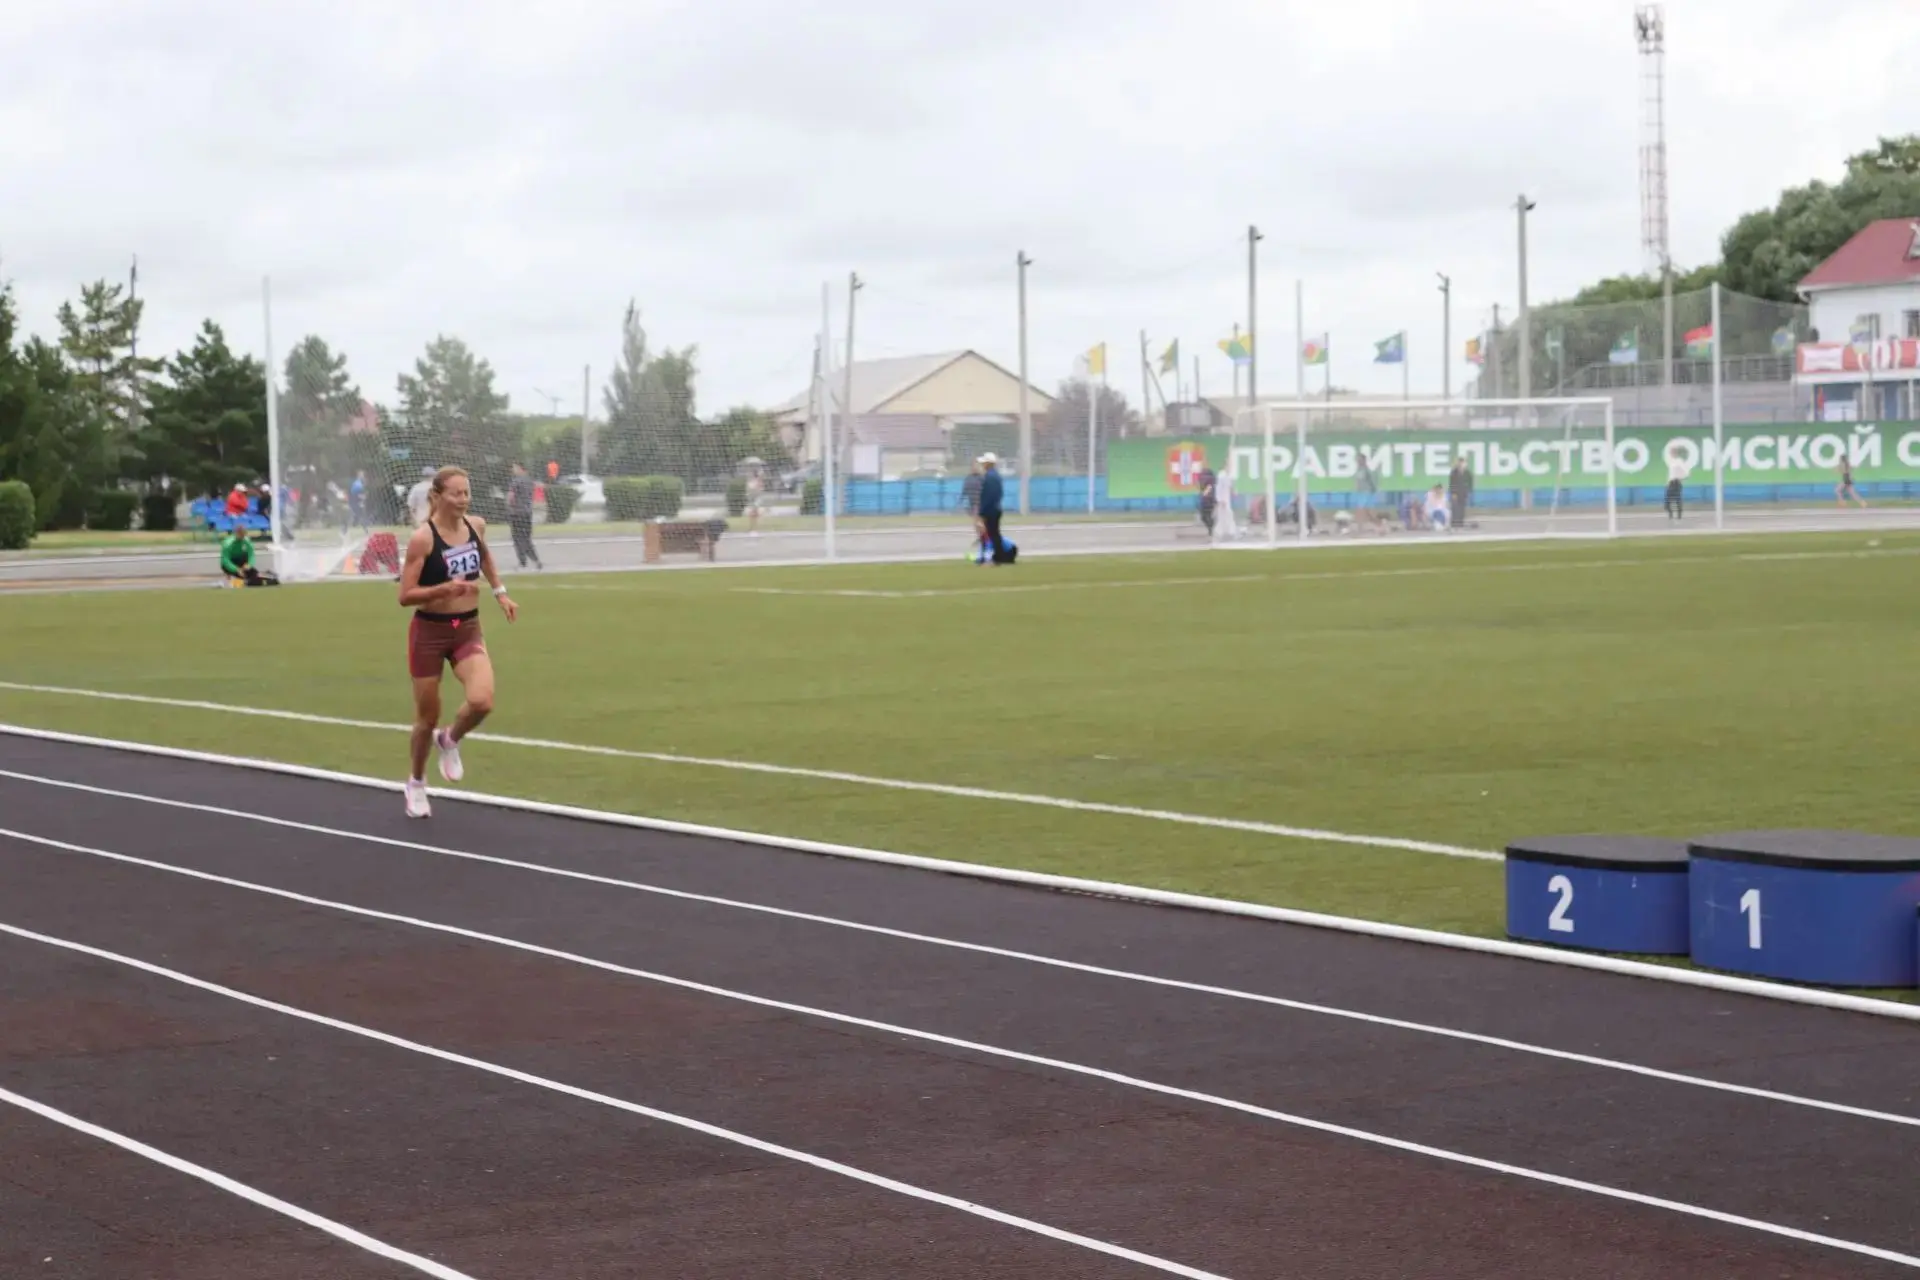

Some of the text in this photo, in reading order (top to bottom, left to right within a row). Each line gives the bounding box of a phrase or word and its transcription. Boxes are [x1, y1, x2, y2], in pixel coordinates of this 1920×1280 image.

[1230, 437, 1650, 479] ПРАВИТЕЛЬСТВО
[1663, 424, 1882, 471] ОМСКОЙ
[450, 553, 478, 575] 213
[1547, 874, 1575, 933] 2
[1739, 888, 1762, 950] 1
